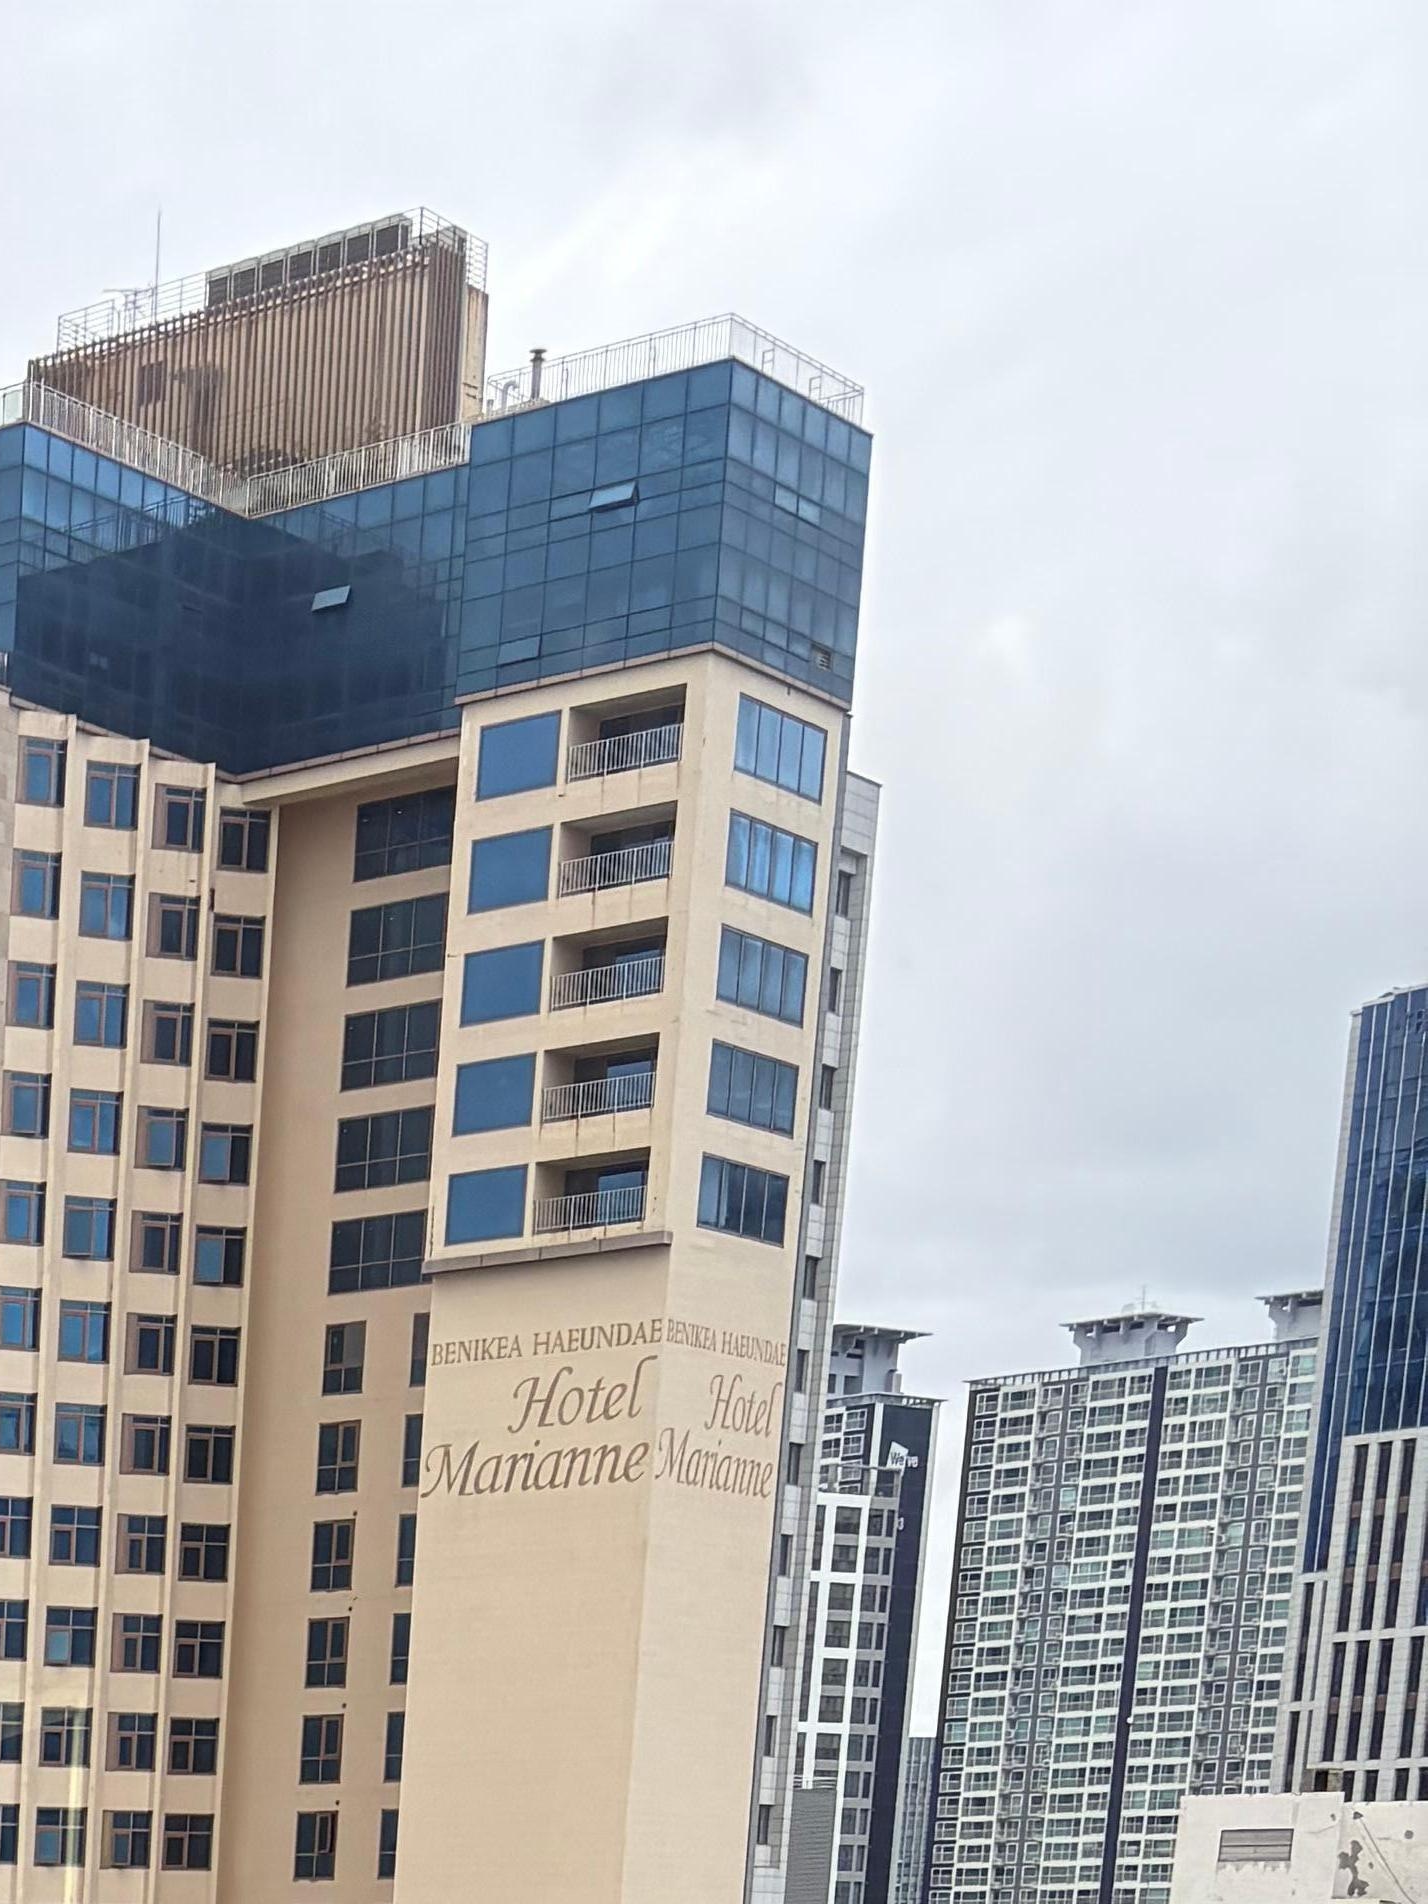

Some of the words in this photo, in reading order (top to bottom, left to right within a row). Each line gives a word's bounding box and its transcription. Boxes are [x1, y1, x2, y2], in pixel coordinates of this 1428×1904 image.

[431, 1334, 523, 1367] BENIKEA
[532, 1318, 663, 1356] HAEUNDAE
[666, 1318, 717, 1353] BENIKEA
[721, 1331, 787, 1367] HAEUNDAE
[507, 1355, 658, 1434] Hotel
[704, 1373, 783, 1437] Hotel
[420, 1439, 650, 1499] Marianne
[654, 1428, 775, 1499] Marianne
